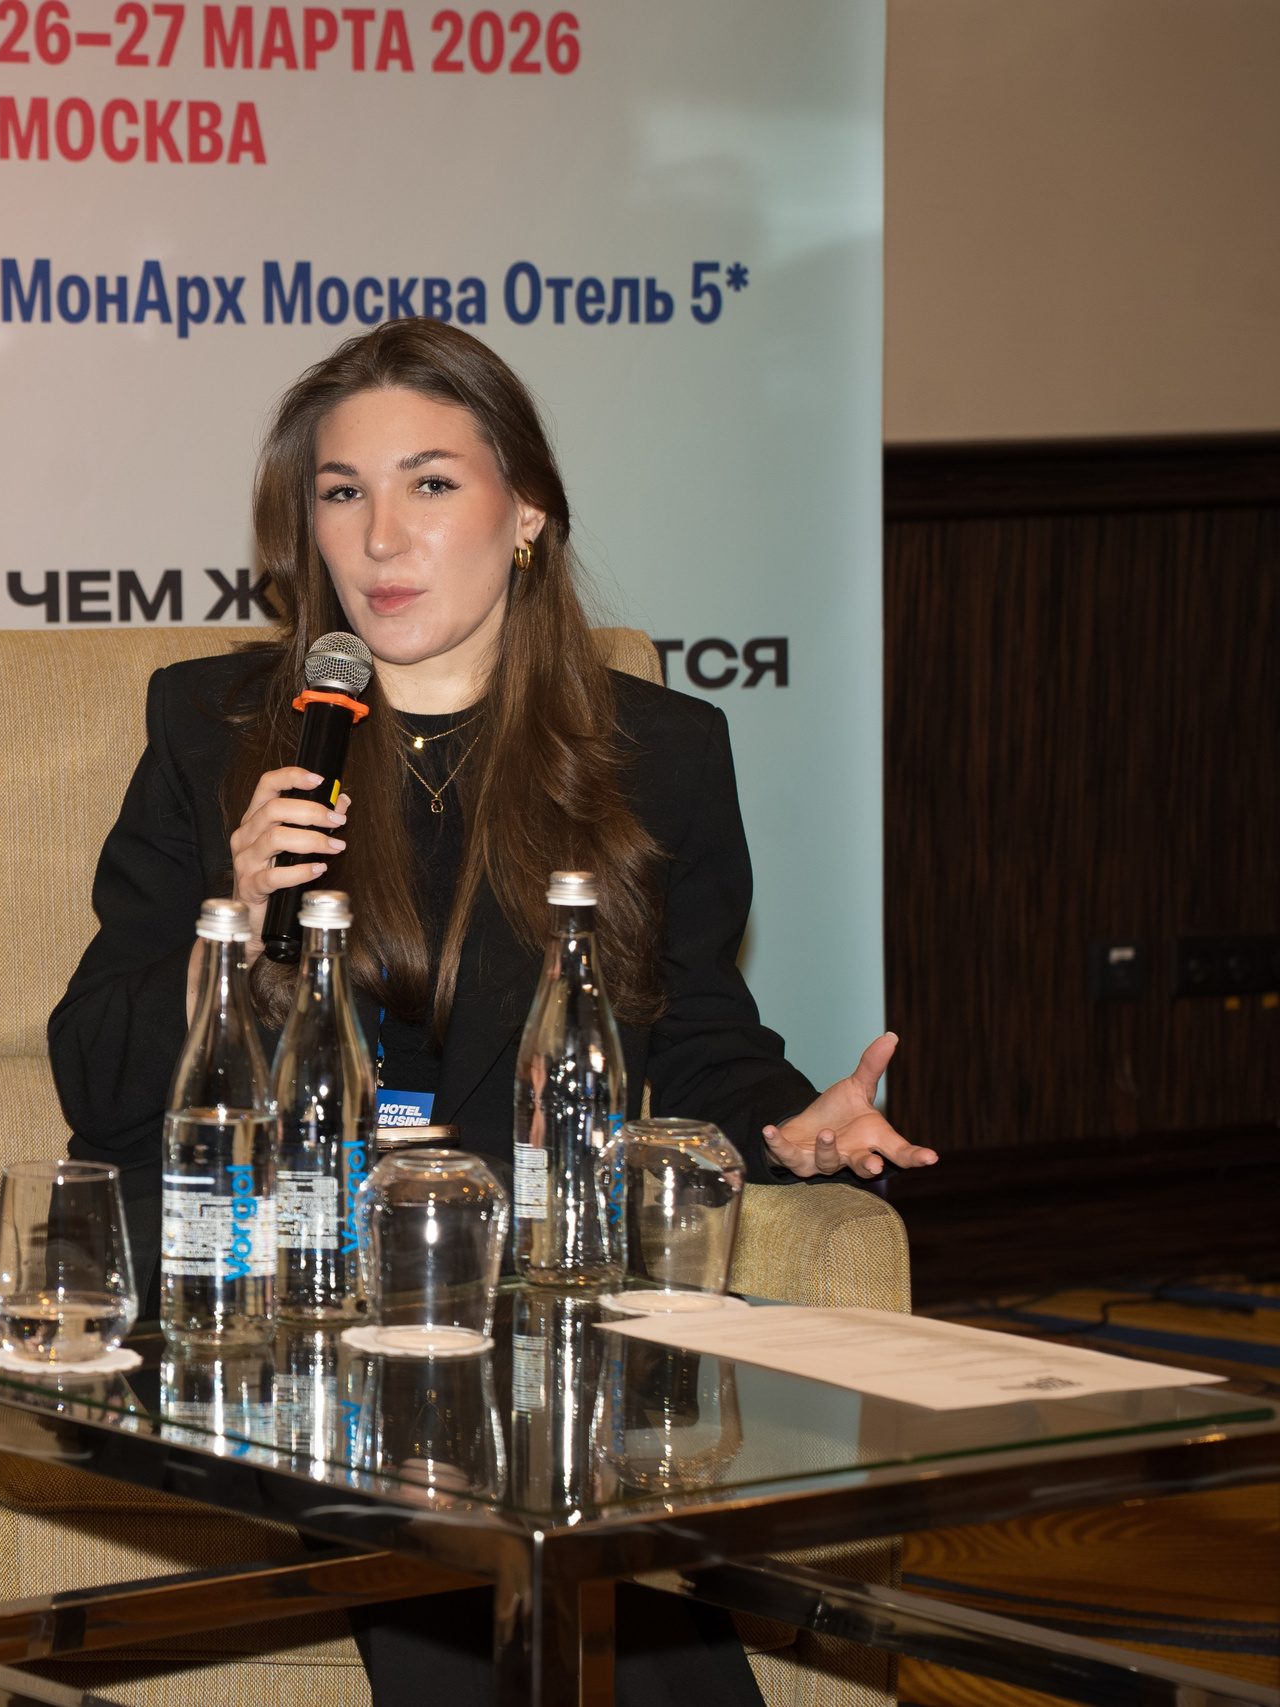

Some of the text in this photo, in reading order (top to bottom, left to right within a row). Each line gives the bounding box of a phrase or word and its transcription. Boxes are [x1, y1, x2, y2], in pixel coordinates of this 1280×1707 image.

[203, 4, 414, 73] МАРТА
[431, 11, 581, 76] 2026
[0, 258, 246, 339] МонАрх
[263, 260, 487, 326] Москва
[503, 260, 675, 326] Отель
[6, 567, 282, 623] ЧЕМ Ж
[652, 636, 789, 691] ТСЯ
[378, 1103, 422, 1117] HOTEL
[224, 1164, 258, 1282] Vorgol
